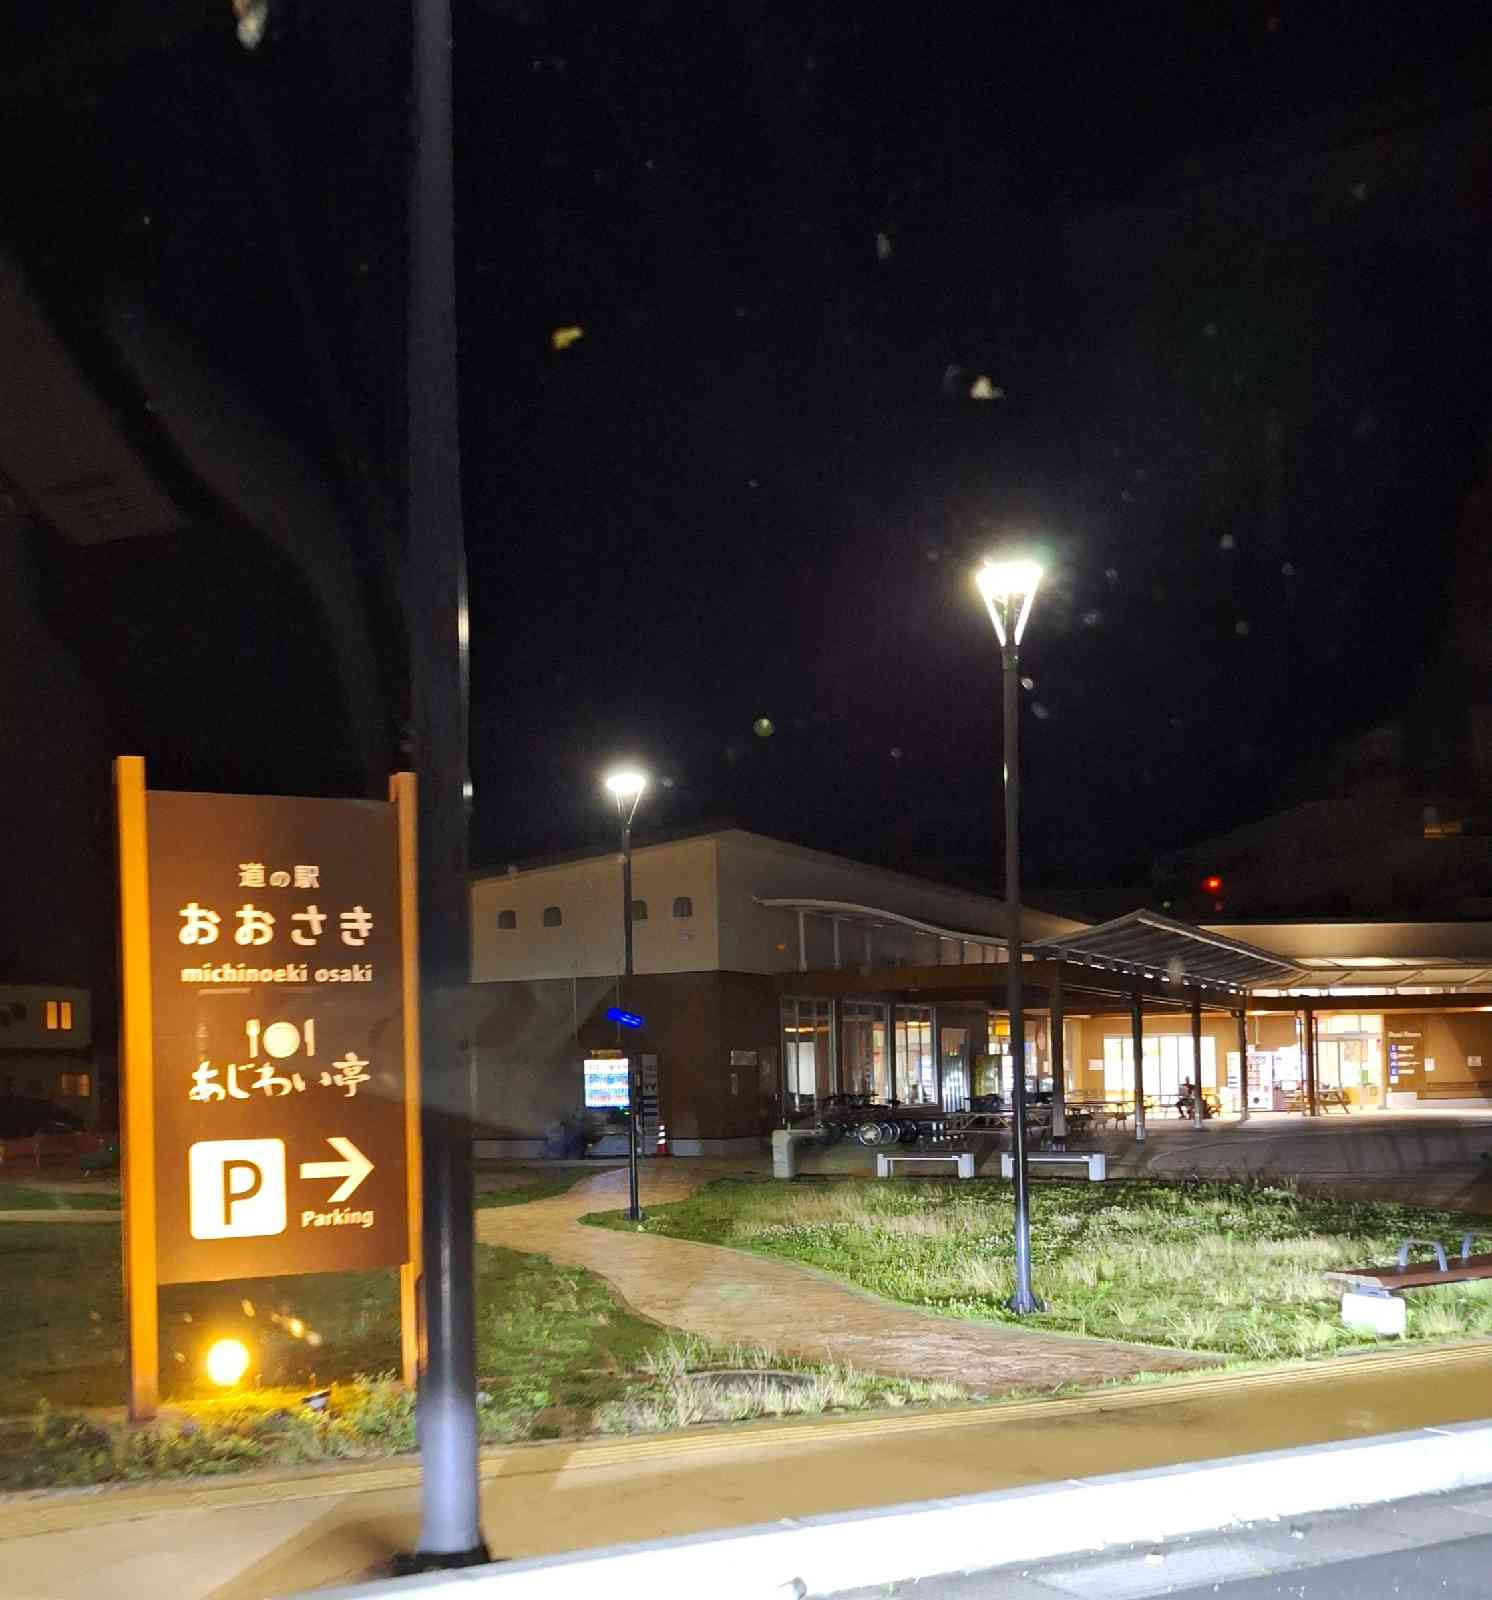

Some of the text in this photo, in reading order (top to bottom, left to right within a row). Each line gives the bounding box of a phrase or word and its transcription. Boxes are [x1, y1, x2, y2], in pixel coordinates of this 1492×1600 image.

[238, 863, 320, 888] 道の駅
[178, 902, 374, 946] おおさき
[180, 963, 373, 982] michinoeki osaki
[188, 1052, 371, 1102] あじわい亭
[222, 1159, 262, 1226] P
[301, 1208, 374, 1228] Parking
